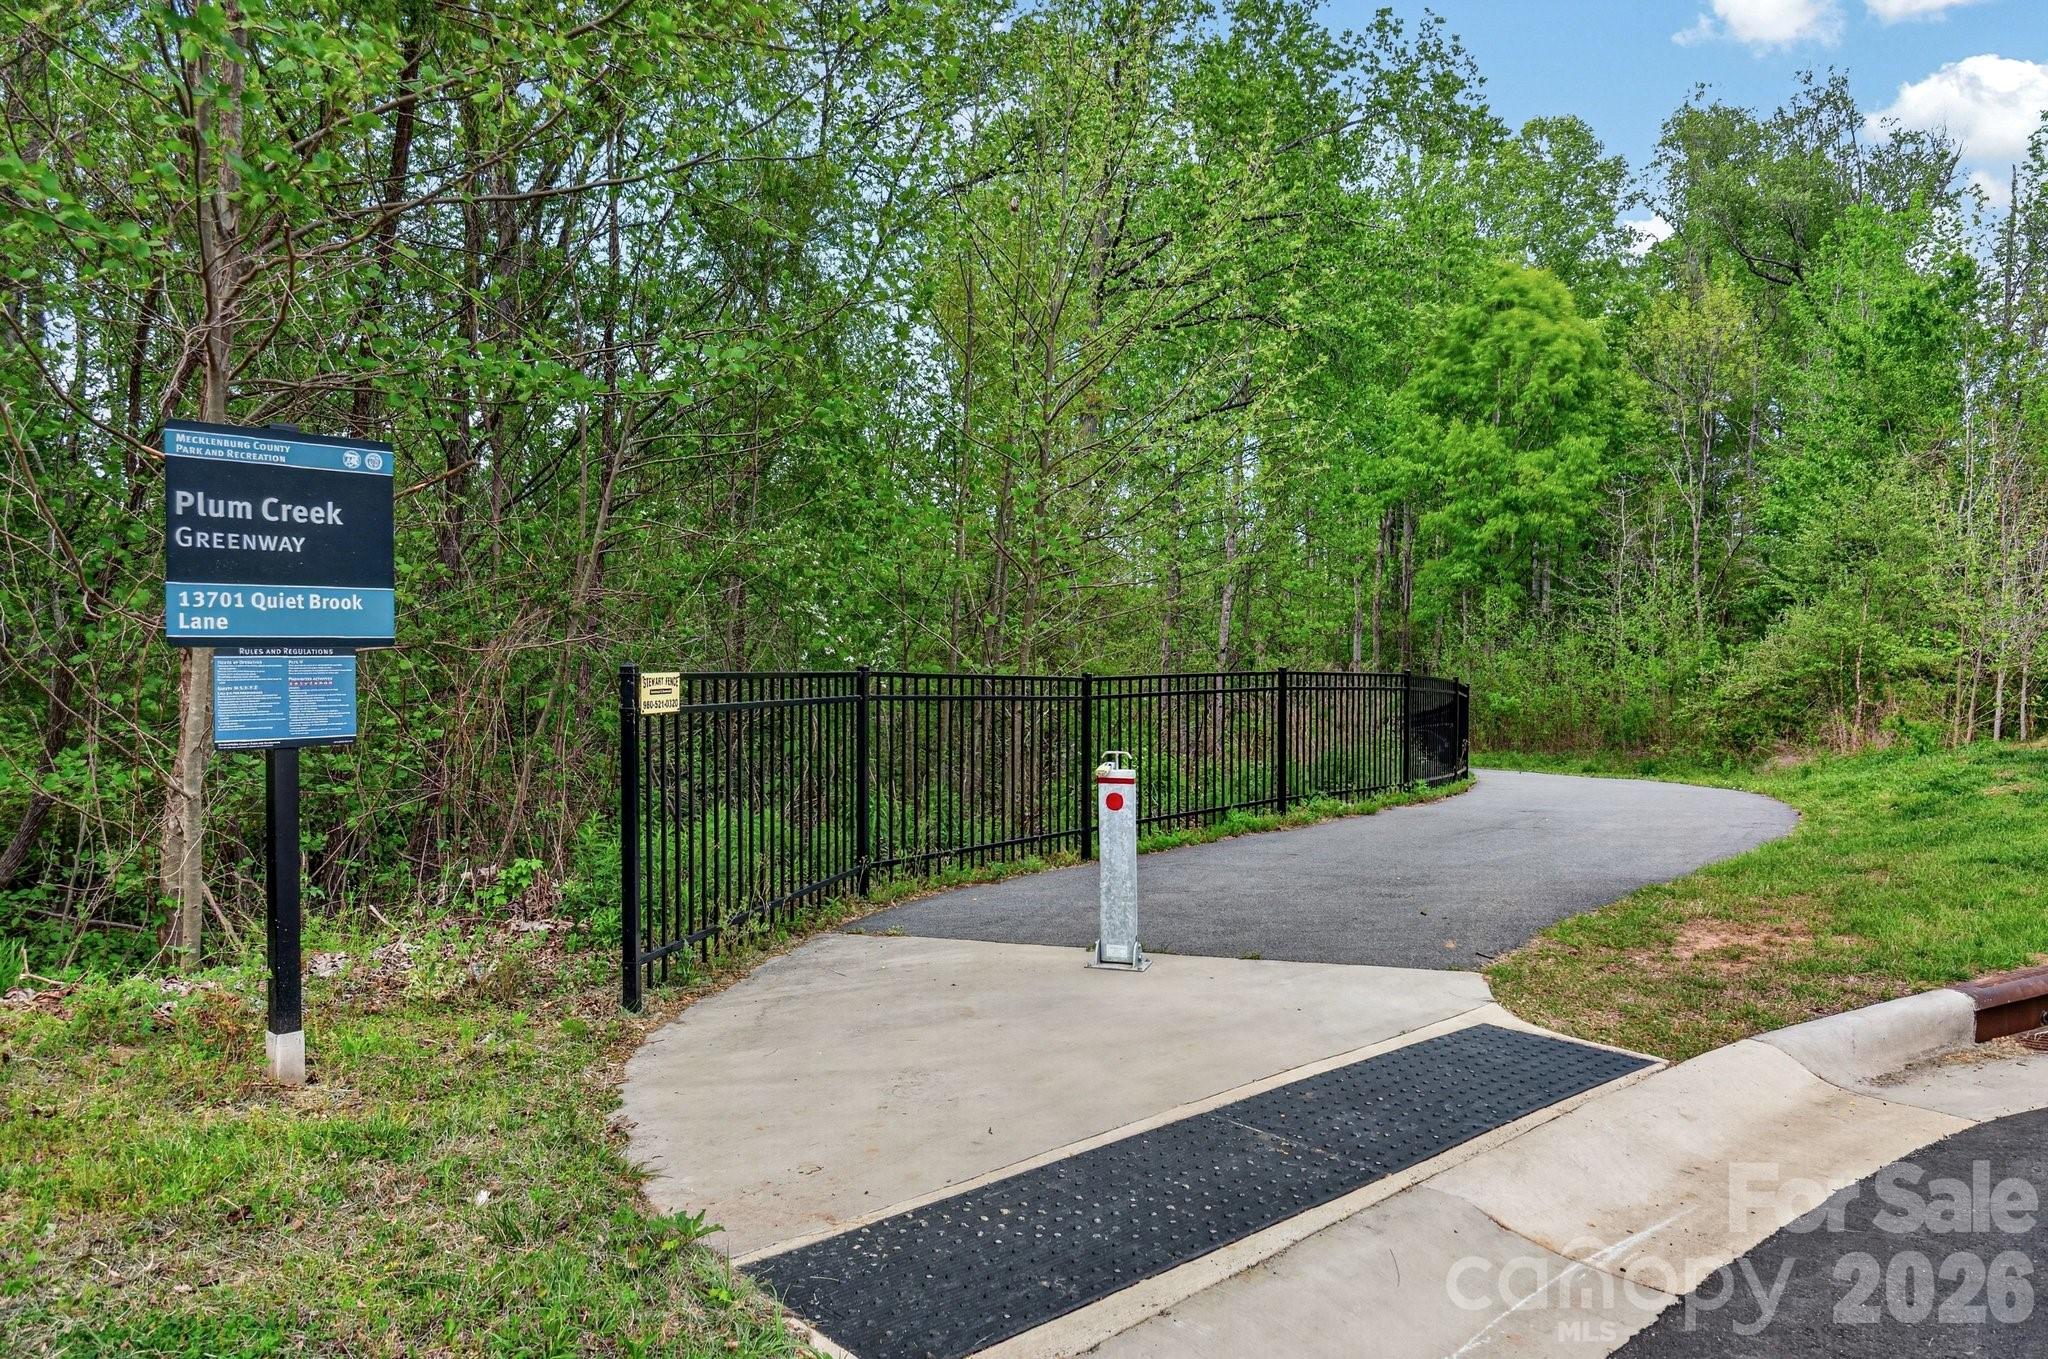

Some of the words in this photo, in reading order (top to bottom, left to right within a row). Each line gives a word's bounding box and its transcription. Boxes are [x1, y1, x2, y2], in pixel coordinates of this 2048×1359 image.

[175, 490, 252, 520] Plum
[261, 497, 343, 525] Creek
[175, 527, 306, 552] GREENWAY
[179, 591, 244, 608] 13701
[251, 592, 304, 611] Quiet
[309, 594, 363, 610] Brook
[179, 613, 229, 629] Lane
[643, 677, 664, 688] STEWART
[665, 676, 678, 687] FENCE
